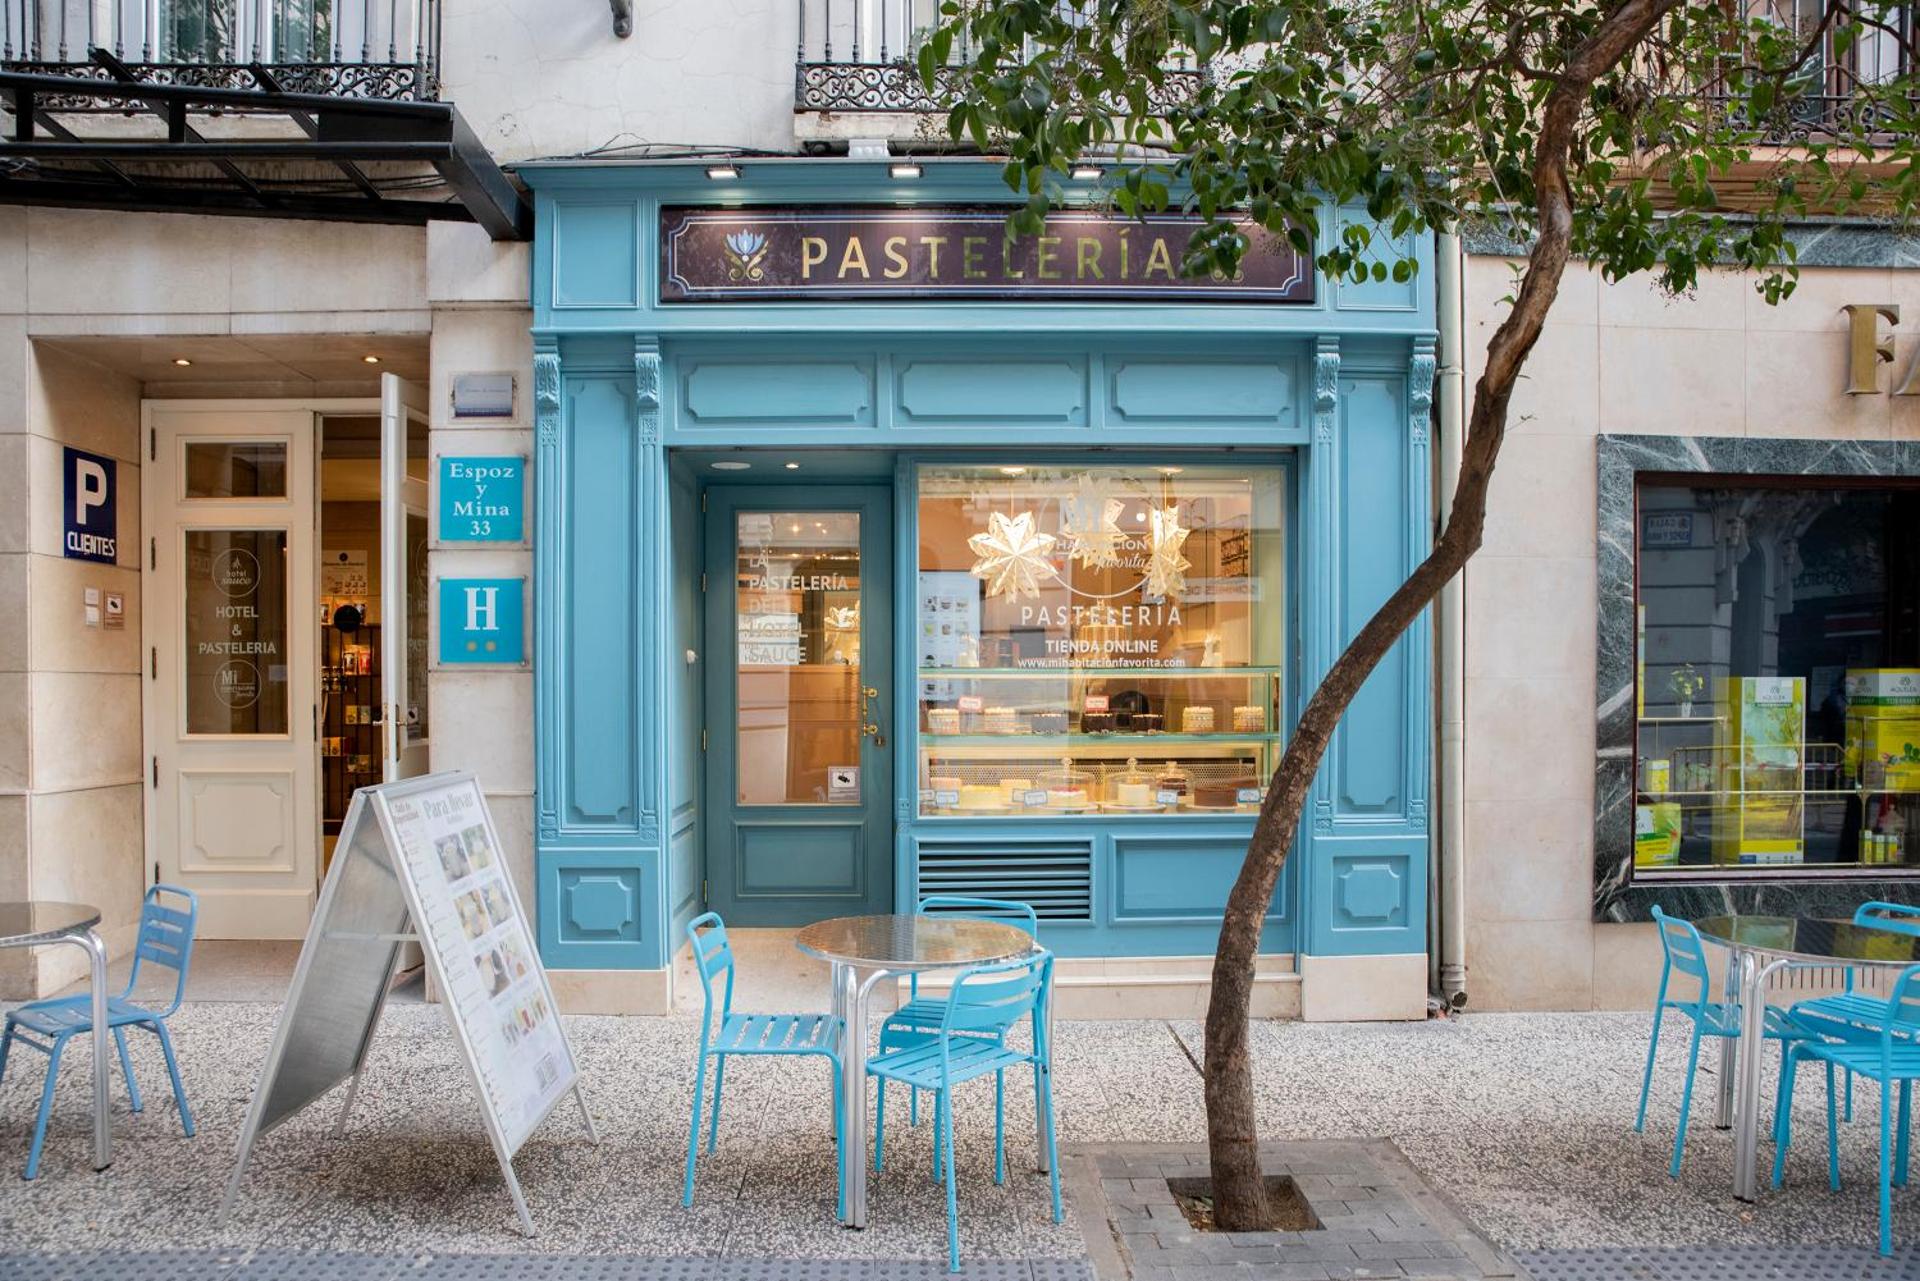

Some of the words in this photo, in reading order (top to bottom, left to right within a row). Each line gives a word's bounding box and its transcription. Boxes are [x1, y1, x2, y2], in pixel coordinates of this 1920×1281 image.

[801, 227, 1176, 280] PASTELERÍA
[449, 462, 515, 482] Espoz
[76, 457, 107, 525] P
[475, 484, 488, 500] y
[452, 501, 510, 516] Mina
[469, 520, 492, 536] 33
[67, 531, 116, 557] CLIENTES
[749, 573, 849, 591] PASTELERÍA
[215, 606, 259, 618] HOTEL
[463, 586, 500, 631] H
[231, 623, 242, 636] &
[198, 642, 277, 655] PASTELERIA
[1045, 640, 1100, 653] TIENDA
[1103, 640, 1158, 653] ONLINE
[749, 647, 808, 663] SAUCE
[221, 670, 238, 685] Mi
